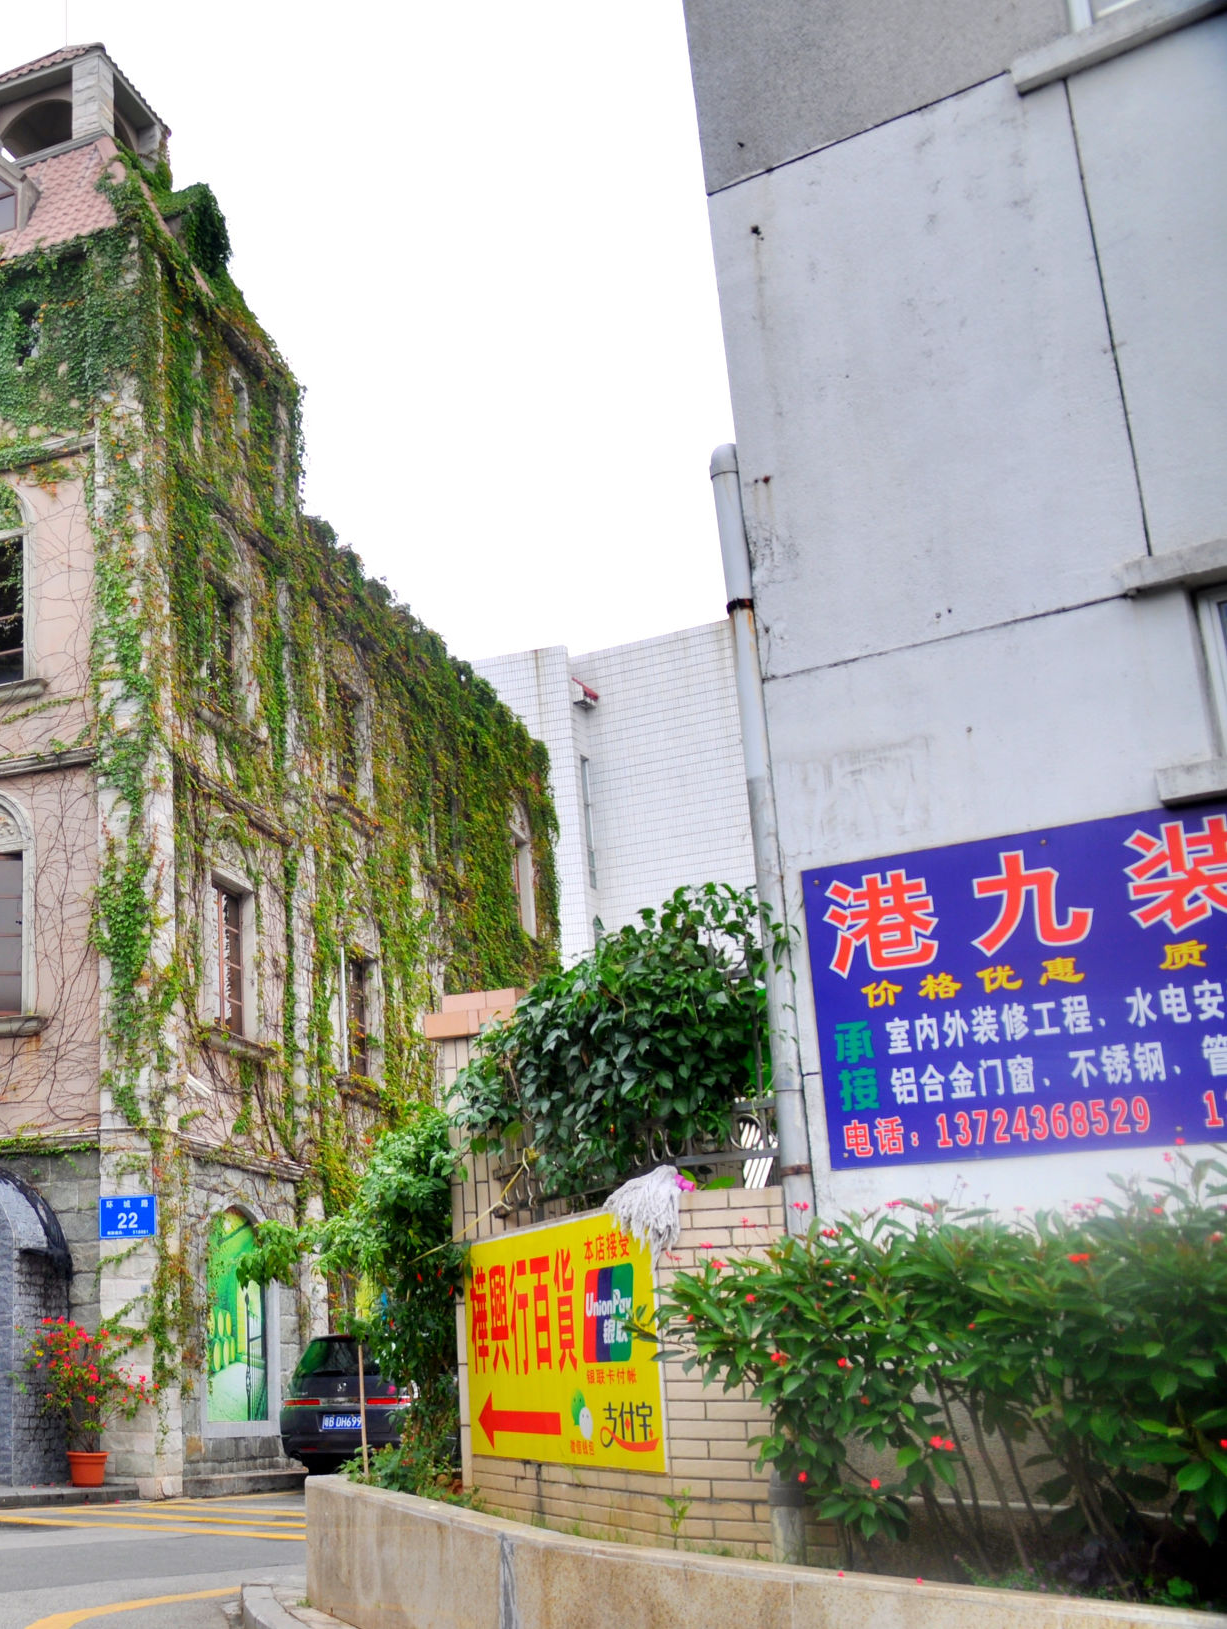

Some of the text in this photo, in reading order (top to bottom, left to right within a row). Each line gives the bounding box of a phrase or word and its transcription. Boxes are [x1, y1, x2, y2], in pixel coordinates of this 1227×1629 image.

[823, 814, 1227, 979] 港九装
[860, 957, 1086, 1008] 价格优惠
[834, 1020, 880, 1112] 承接
[1203, 1090, 1227, 1128] 1
[117, 1211, 138, 1229] 22
[584, 1231, 630, 1264] 本店接受
[585, 1288, 632, 1320] UnionPay
[600, 1401, 660, 1451] 支付宝
